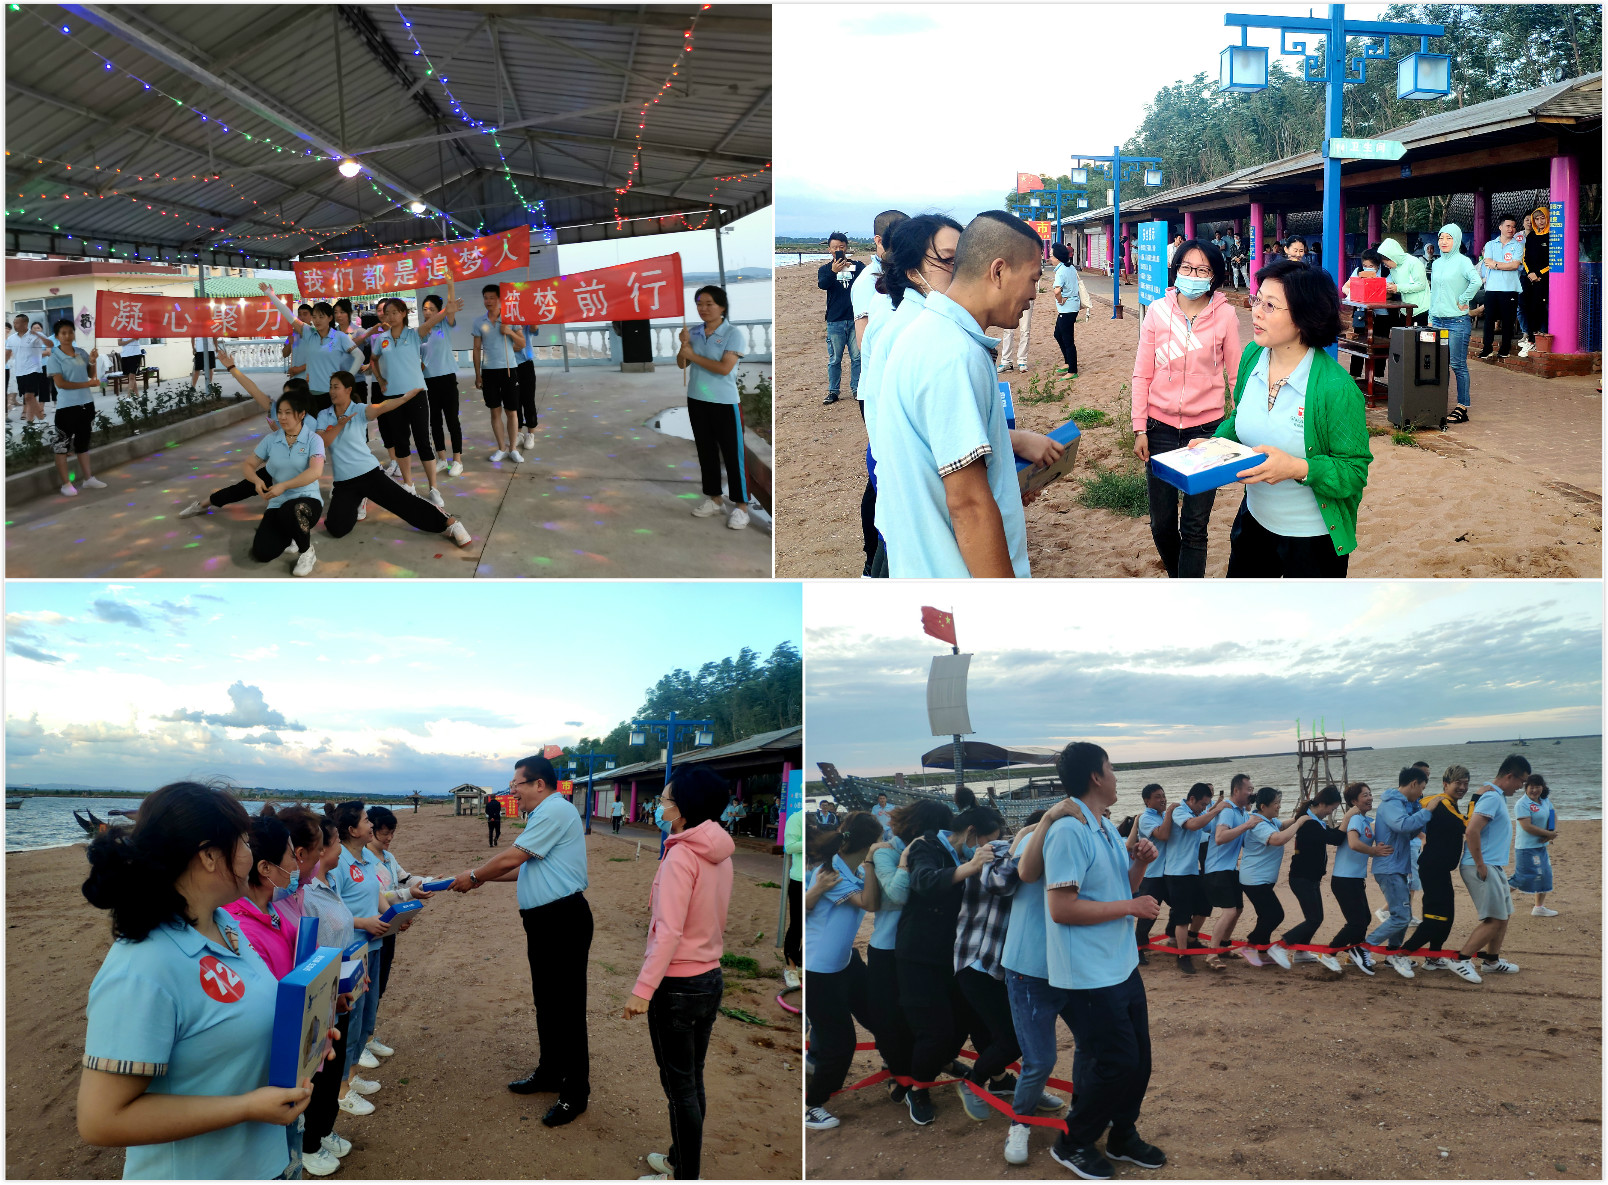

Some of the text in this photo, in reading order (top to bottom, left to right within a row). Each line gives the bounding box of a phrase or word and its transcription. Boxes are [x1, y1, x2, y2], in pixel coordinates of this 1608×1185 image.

[1350, 141, 1386, 153] 卫生间
[304, 238, 518, 293] 我们都是追梦人
[504, 270, 666, 322] 筑梦前行
[110, 300, 282, 333] 凝心聚力
[203, 962, 241, 996] 72
